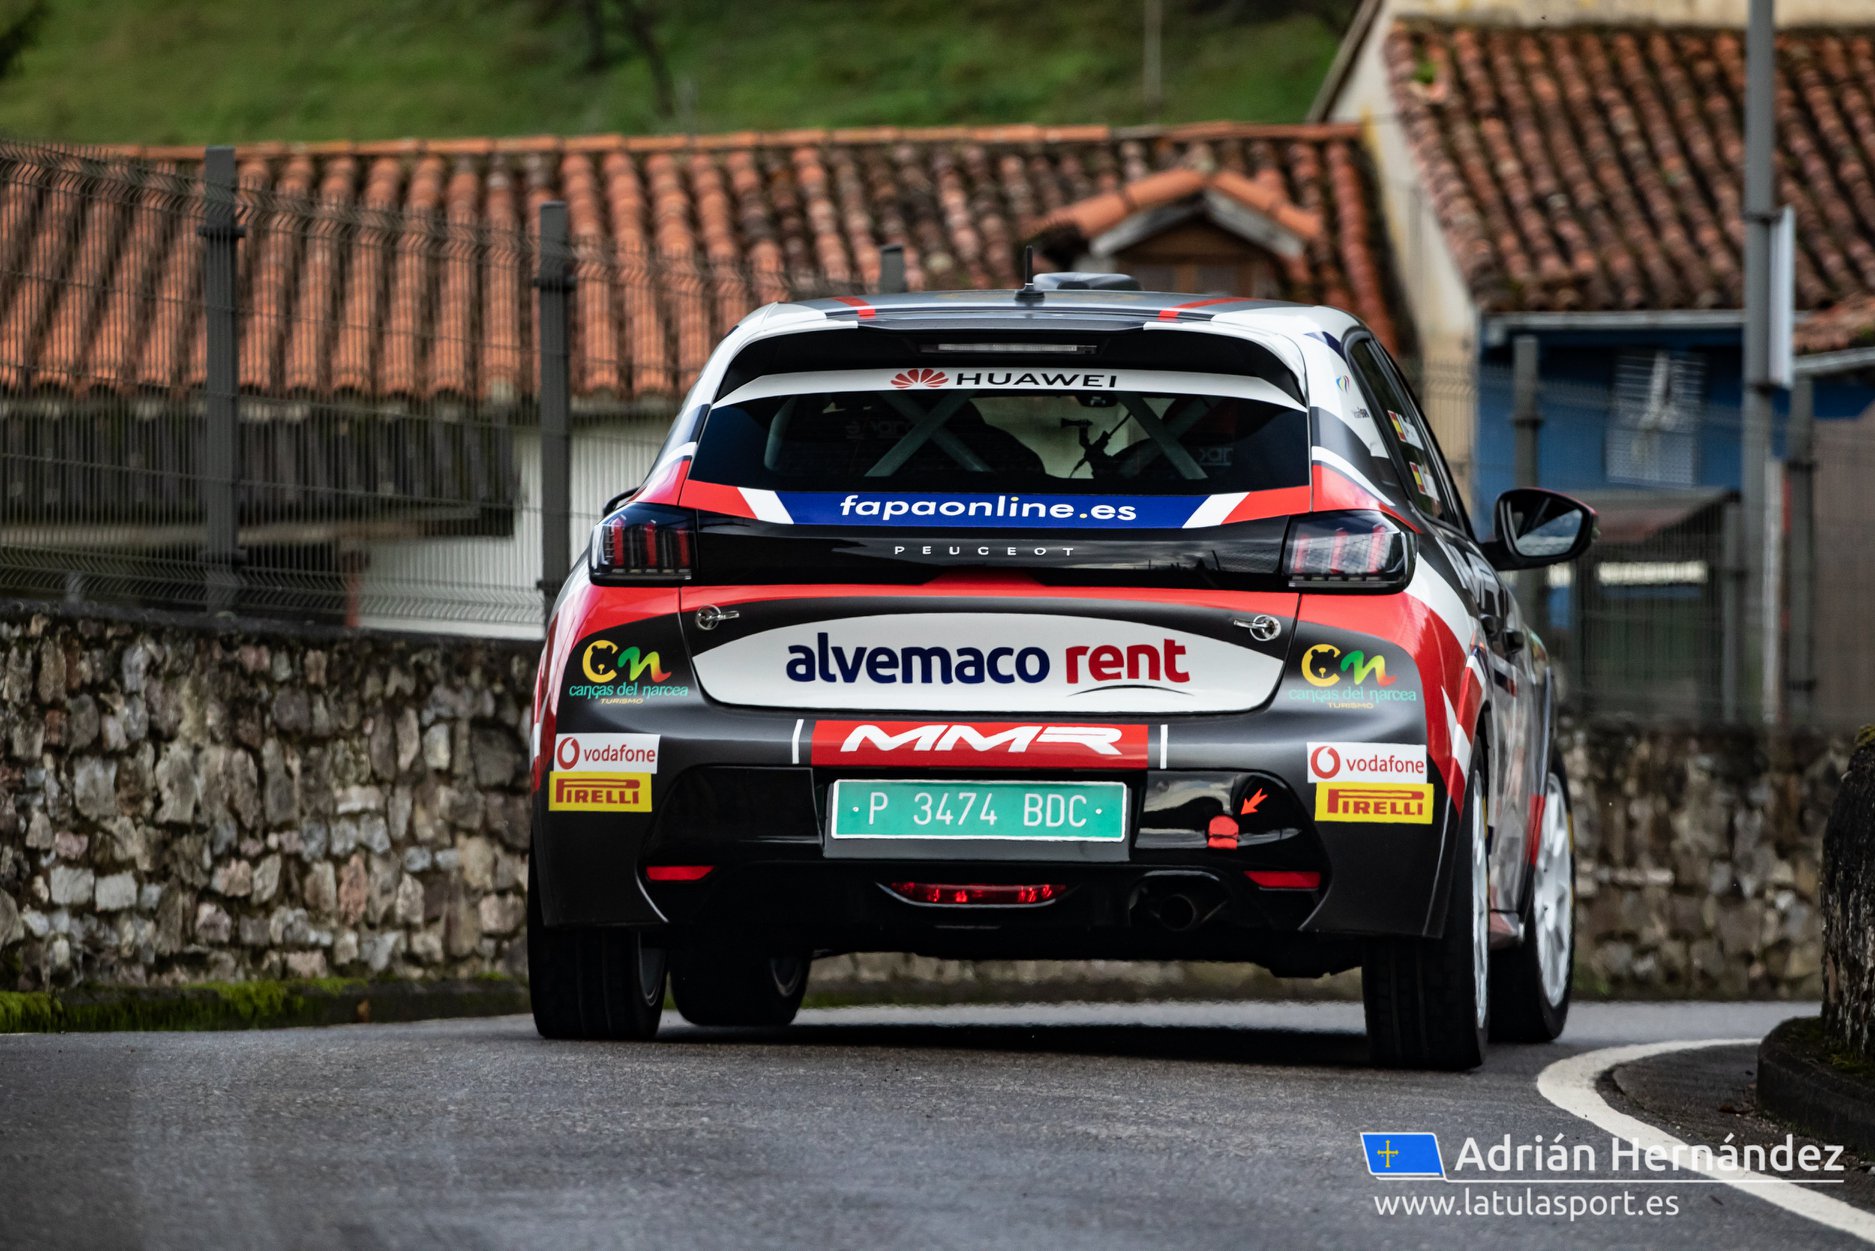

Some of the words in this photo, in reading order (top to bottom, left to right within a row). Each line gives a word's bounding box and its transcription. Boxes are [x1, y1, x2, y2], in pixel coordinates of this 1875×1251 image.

[956, 373, 1117, 388] HUAWEI
[840, 495, 1137, 521] fapaonline.es
[894, 546, 1074, 556] PEUGEOT
[786, 632, 1050, 684] alvemaco
[1065, 638, 1191, 684] rent
[616, 682, 638, 696] del
[1342, 686, 1364, 700] del
[840, 724, 1123, 755] MMR
[584, 744, 655, 762] vodafone
[1346, 755, 1425, 773] vodafone
[556, 779, 640, 804] PIRELLI
[1327, 788, 1425, 815] PIRELLI
[868, 792, 889, 825] P
[913, 792, 998, 826] 3474
[1023, 794, 1087, 827] BDC
